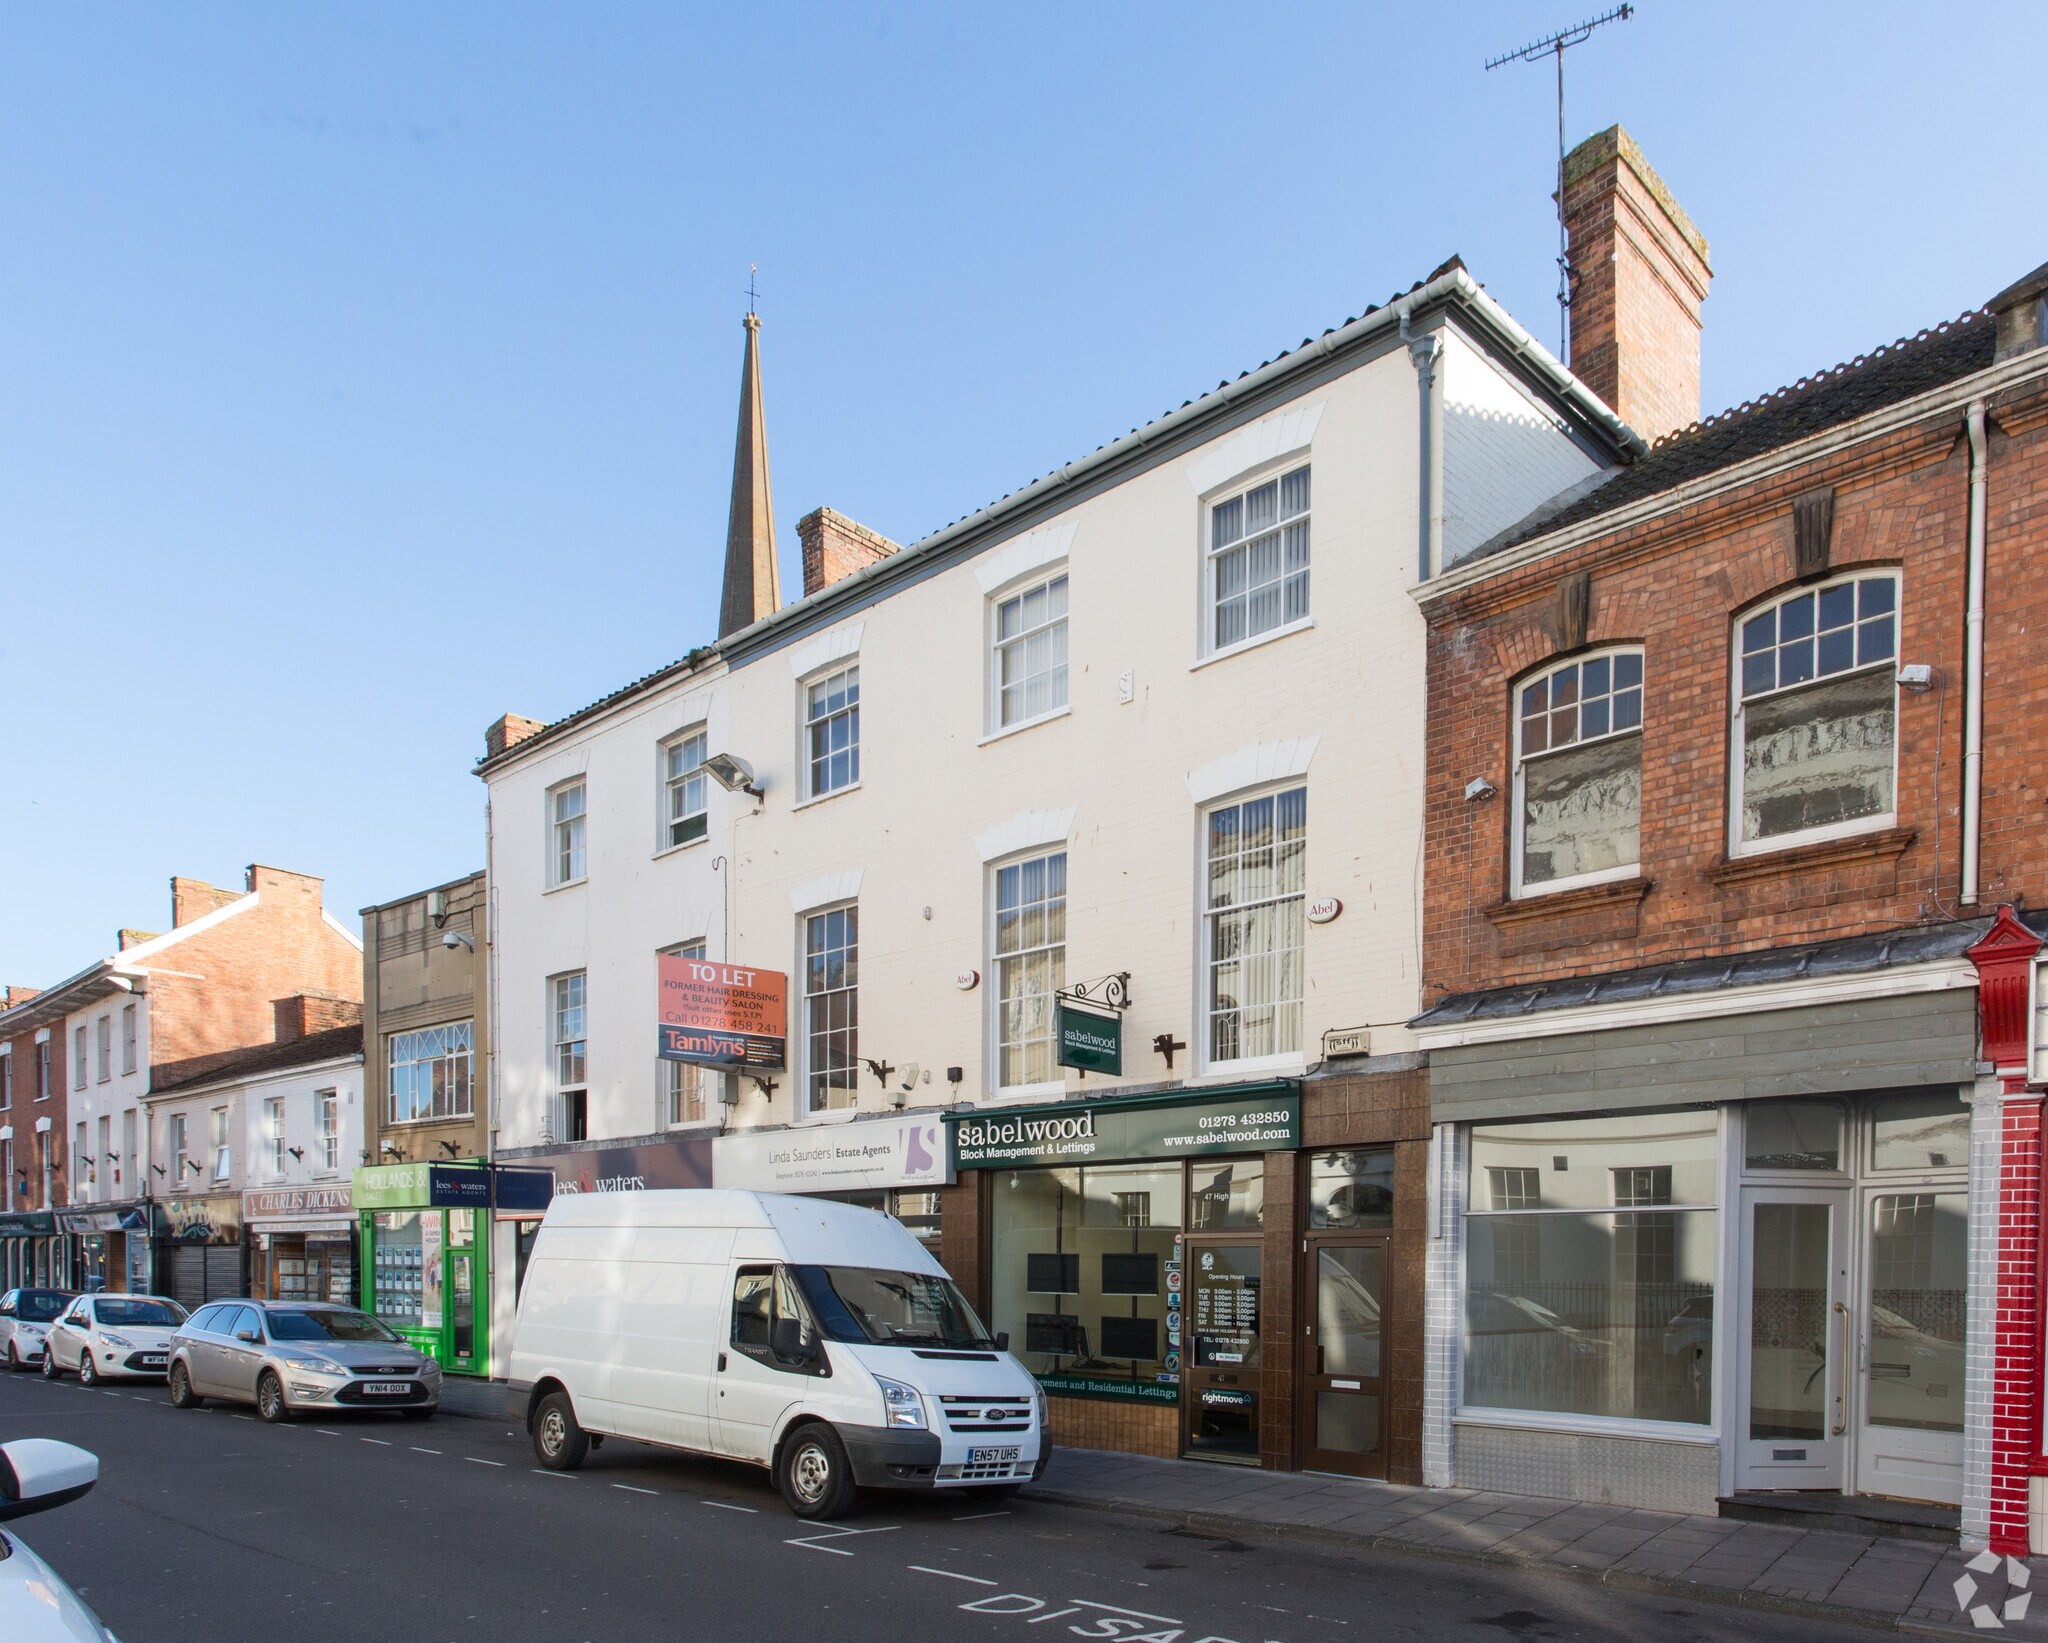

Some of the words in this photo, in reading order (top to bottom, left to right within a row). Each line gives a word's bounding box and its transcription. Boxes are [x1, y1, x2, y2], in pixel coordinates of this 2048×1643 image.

[1310, 901, 1333, 916] Abel
[689, 963, 716, 982] TO
[722, 968, 756, 987] LET
[956, 974, 972, 984] Abel
[664, 980, 704, 992] FORMER
[707, 987, 729, 996] HAIR
[732, 989, 779, 1002] DRESSING
[692, 994, 729, 1007] BEAUTY
[732, 1000, 763, 1010] SALON
[703, 1005, 721, 1014] other
[666, 1012, 687, 1023] Call
[691, 1015, 726, 1028] 01278
[731, 1020, 752, 1031] 458
[757, 1024, 777, 1034] 241
[666, 1030, 744, 1057] Tamlyns
[1065, 1030, 1116, 1049] sabelwood
[958, 1109, 1097, 1147] sabelwood
[1198, 1115, 1236, 1129] 01278
[1240, 1110, 1290, 1126] 432850
[1164, 1128, 1291, 1147] www.sabelwood.com
[769, 1150, 791, 1164] Linda
[793, 1146, 831, 1161] Saunders
[836, 1147, 861, 1158] Estate
[862, 1145, 890, 1158] Agents
[960, 1148, 985, 1160] Block
[986, 1145, 1045, 1159] Management
[1046, 1144, 1054, 1154] &
[1056, 1141, 1096, 1156] Lettings
[365, 1171, 414, 1189] HOLLANDS
[417, 1171, 426, 1187] &
[436, 1180, 451, 1189] lees
[461, 1182, 486, 1191] waters
[552, 1172, 578, 1195] lees
[596, 1174, 644, 1193] waters
[260, 1193, 303, 1210] CHARLES
[306, 1190, 350, 1208] DICKENS
[1214, 1193, 1229, 1201] High
[744, 1347, 767, 1355] TRANSIT
[1070, 1382, 1085, 1390] and
[1088, 1382, 1135, 1394] Residential
[1138, 1386, 1176, 1399] Lettings
[1202, 1393, 1243, 1404] rightmove
[974, 1449, 999, 1461] EN57
[1001, 1448, 1018, 1460] UHS
